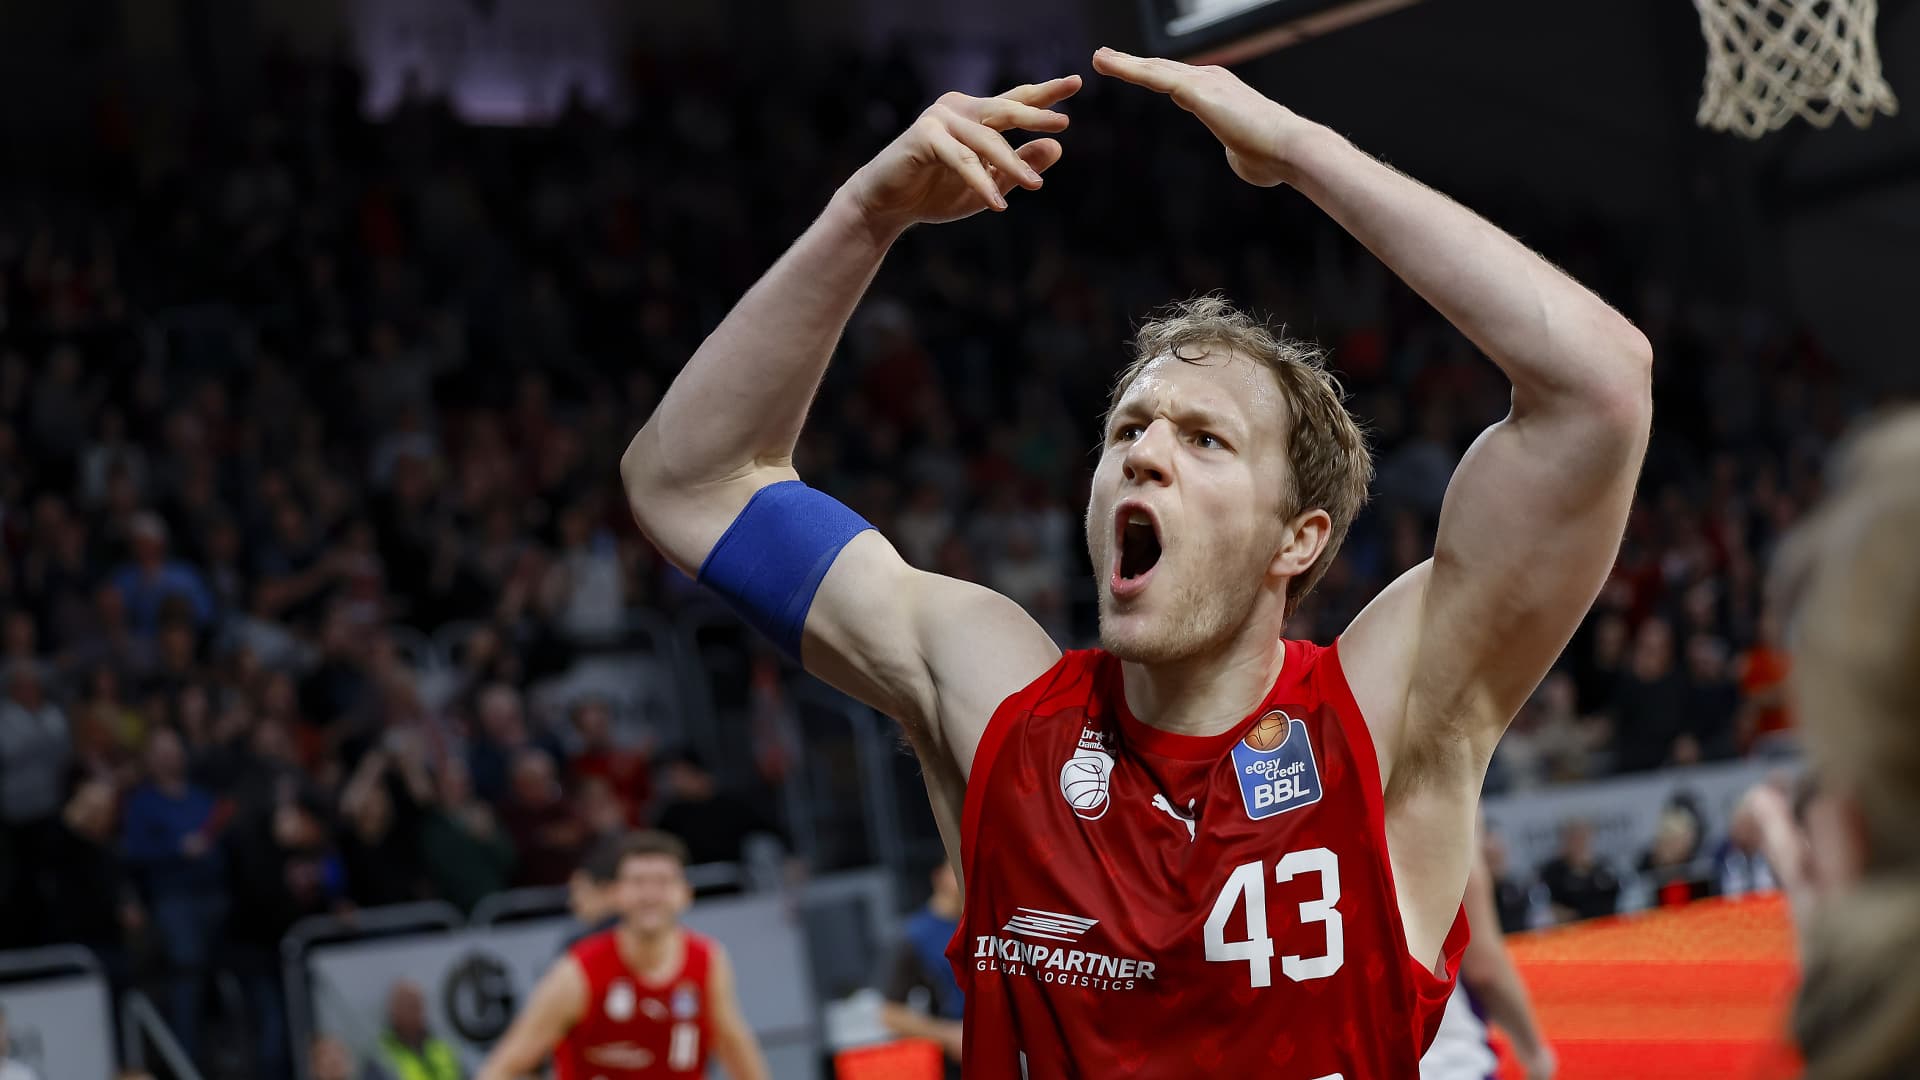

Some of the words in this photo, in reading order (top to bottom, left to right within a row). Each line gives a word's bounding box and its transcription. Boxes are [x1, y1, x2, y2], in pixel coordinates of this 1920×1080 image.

[1264, 761, 1305, 780] Credit
[1254, 775, 1310, 809] BBL
[1203, 847, 1344, 988] 43
[1036, 969, 1135, 990] LOGISTICS
